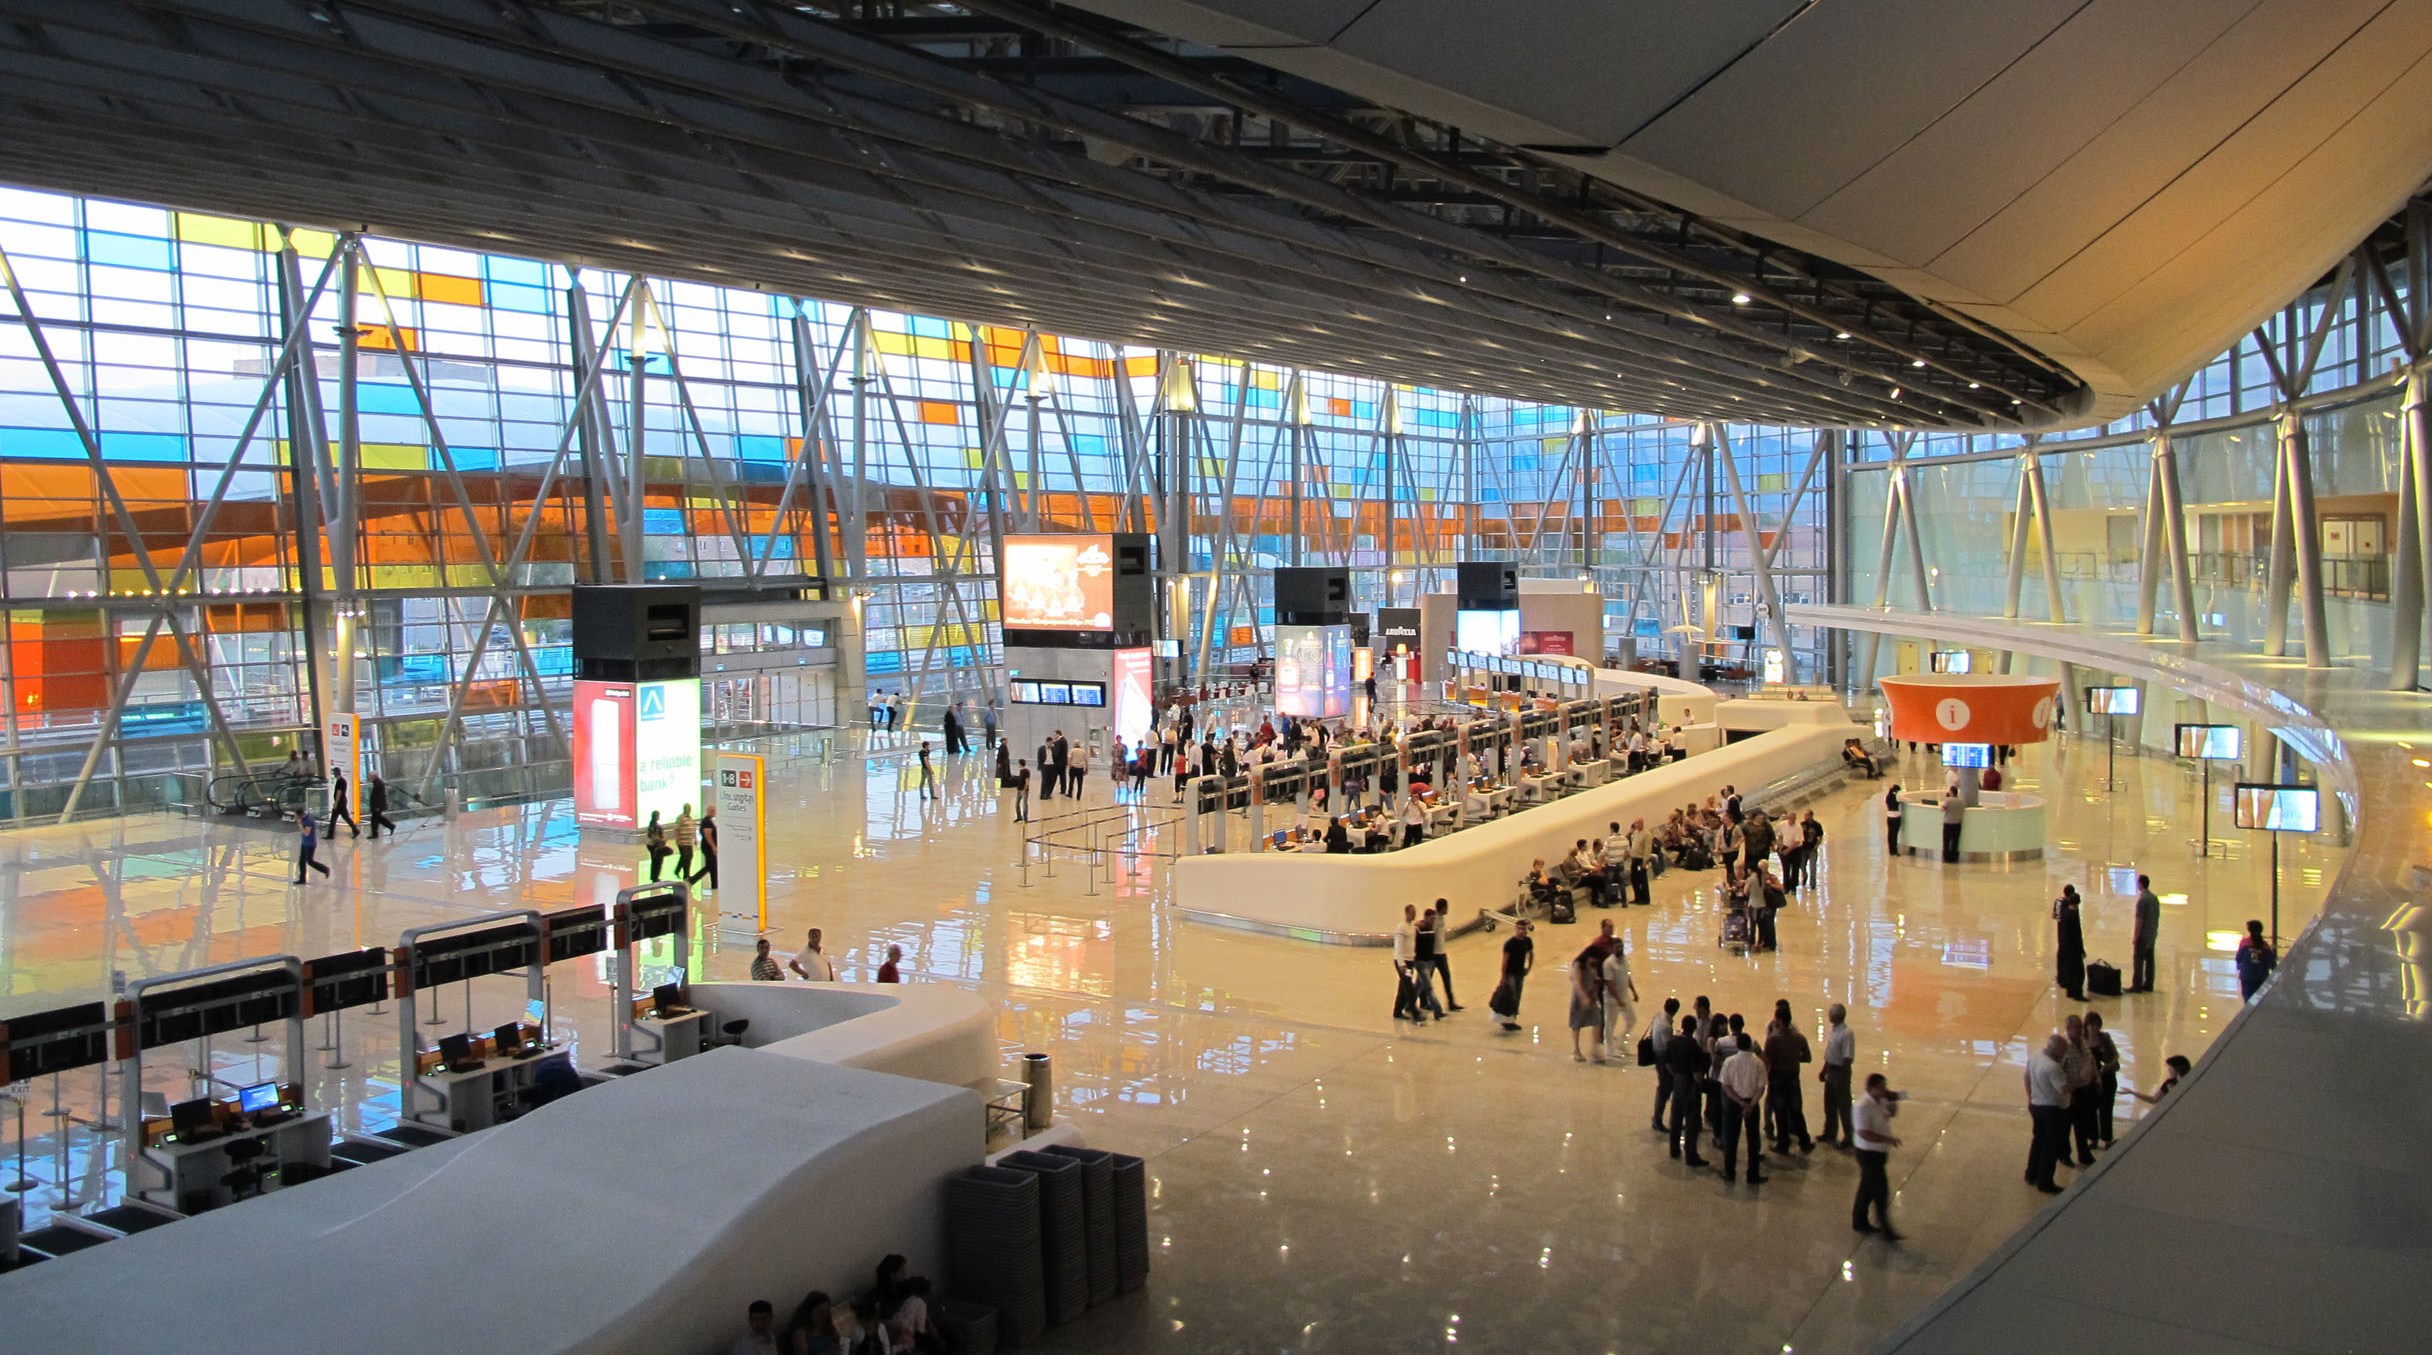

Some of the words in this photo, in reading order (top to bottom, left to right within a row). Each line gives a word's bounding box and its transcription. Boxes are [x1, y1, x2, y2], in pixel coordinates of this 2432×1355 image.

[1949, 705, 1957, 724] i
[640, 761, 646, 772] a
[651, 754, 692, 771] reliable
[640, 774, 674, 792] bank?
[722, 773, 735, 784] 1-8
